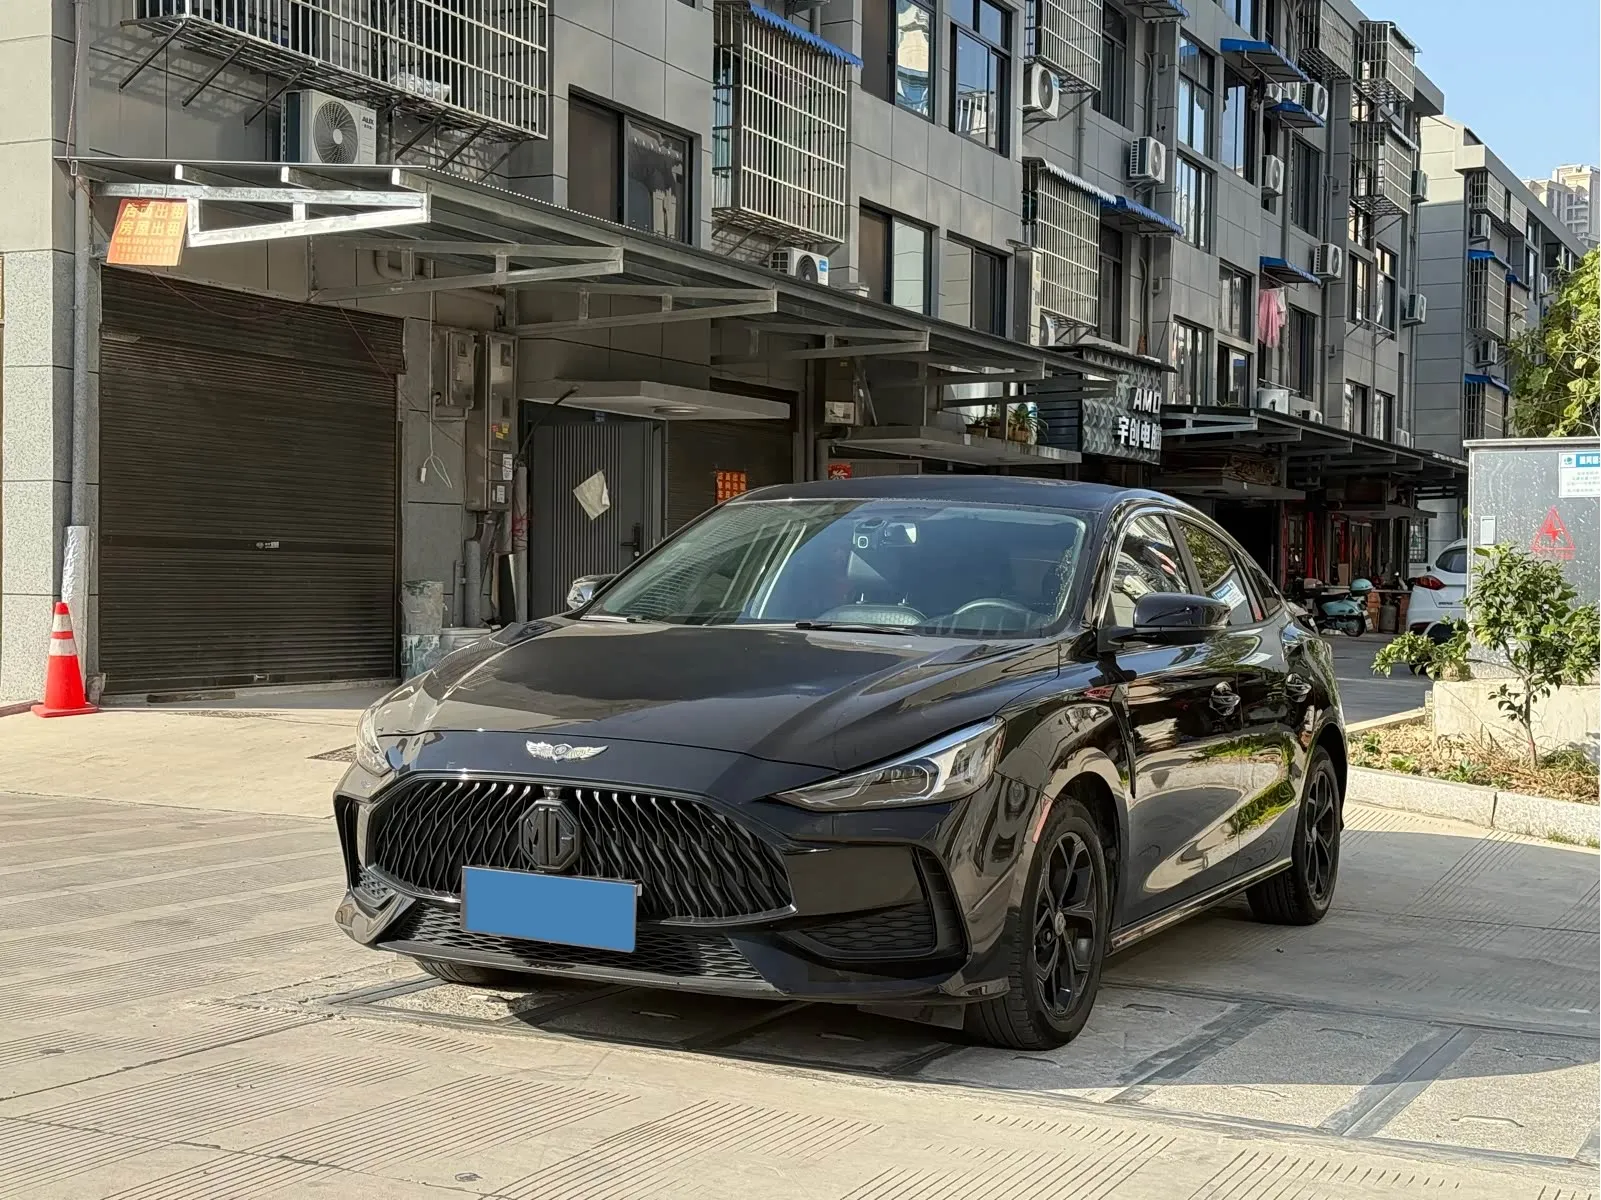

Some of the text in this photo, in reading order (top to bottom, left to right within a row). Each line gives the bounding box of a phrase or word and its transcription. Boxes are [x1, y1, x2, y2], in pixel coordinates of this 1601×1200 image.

[118, 220, 180, 236] 房屋出租
[1118, 416, 1162, 450] 宇创电脑
[523, 806, 574, 865] MG
